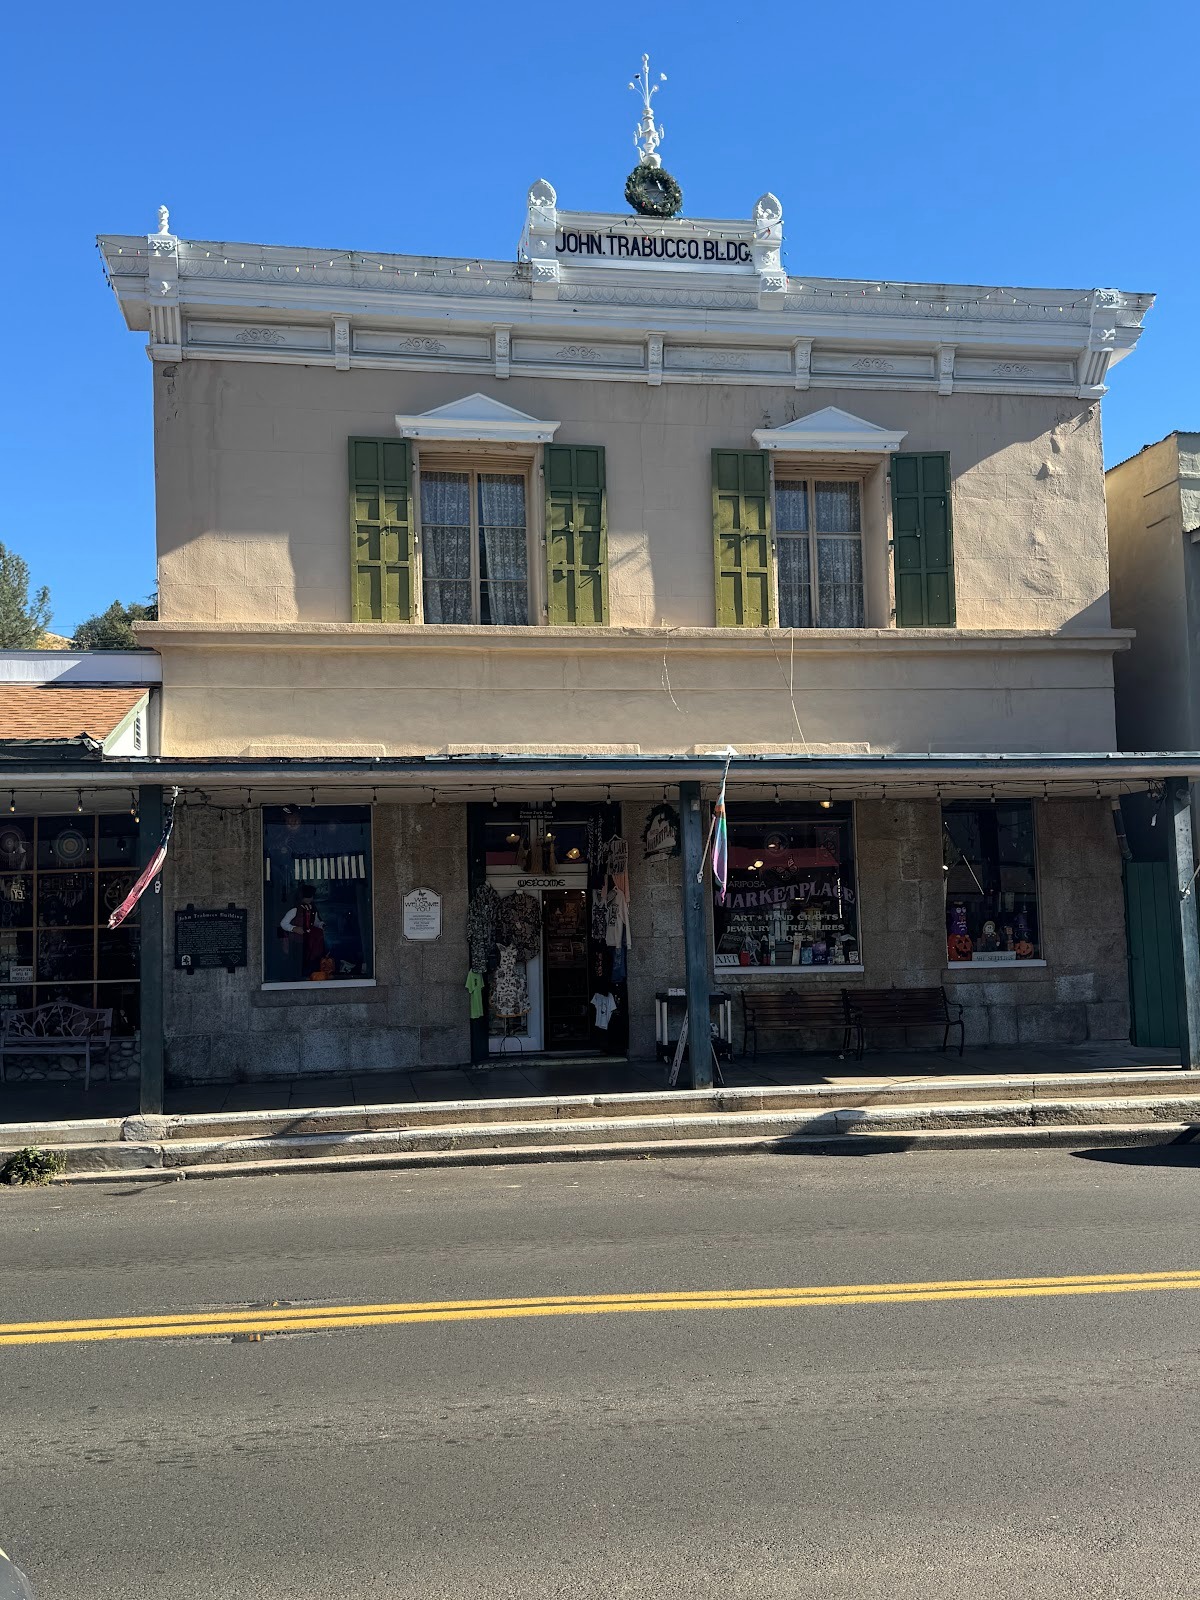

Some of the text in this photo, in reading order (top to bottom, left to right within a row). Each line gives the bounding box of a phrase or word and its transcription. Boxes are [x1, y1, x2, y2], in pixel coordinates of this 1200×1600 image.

[727, 880, 767, 888] ARIPOSA
[714, 881, 856, 908] MARKETPLACE
[797, 913, 839, 921] CRAFTS
[726, 923, 845, 933] JEWELRY TREASURES
[716, 955, 738, 964] ART
